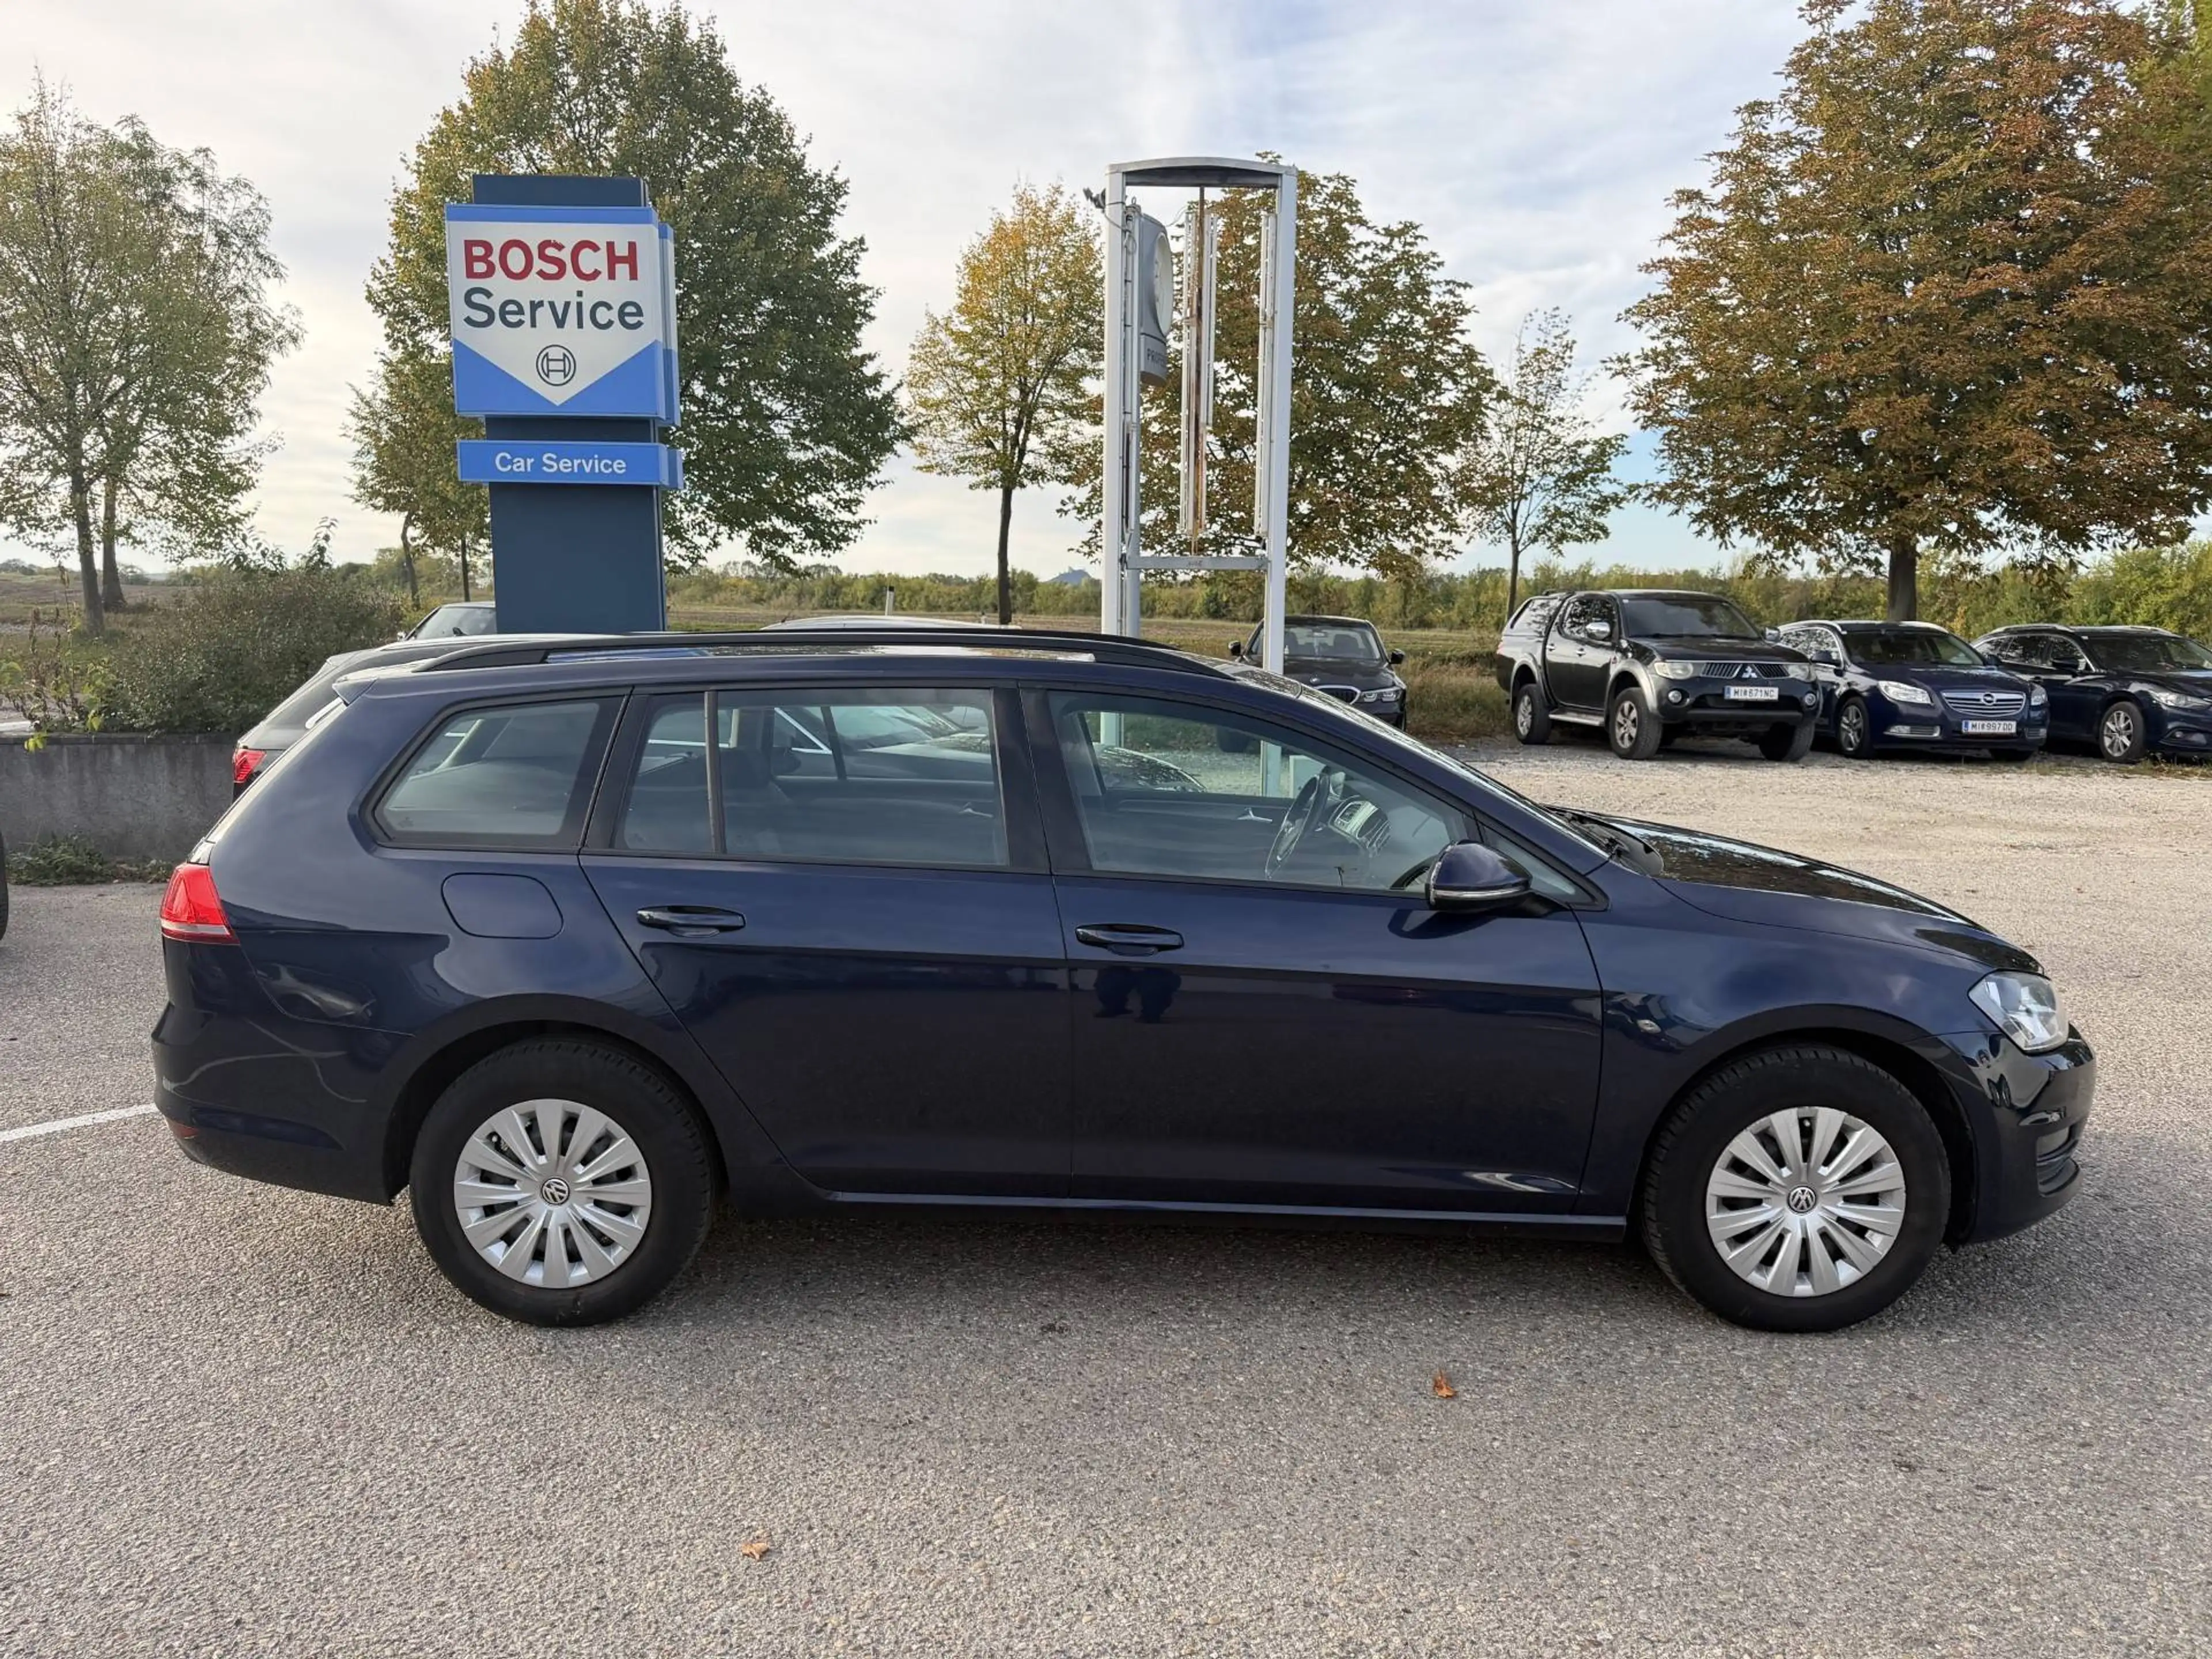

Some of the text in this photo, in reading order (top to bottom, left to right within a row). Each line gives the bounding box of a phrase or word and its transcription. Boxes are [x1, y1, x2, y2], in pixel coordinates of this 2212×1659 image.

[464, 239, 638, 281] BOSCH
[463, 287, 644, 331] Service
[495, 452, 627, 474] Car Service
